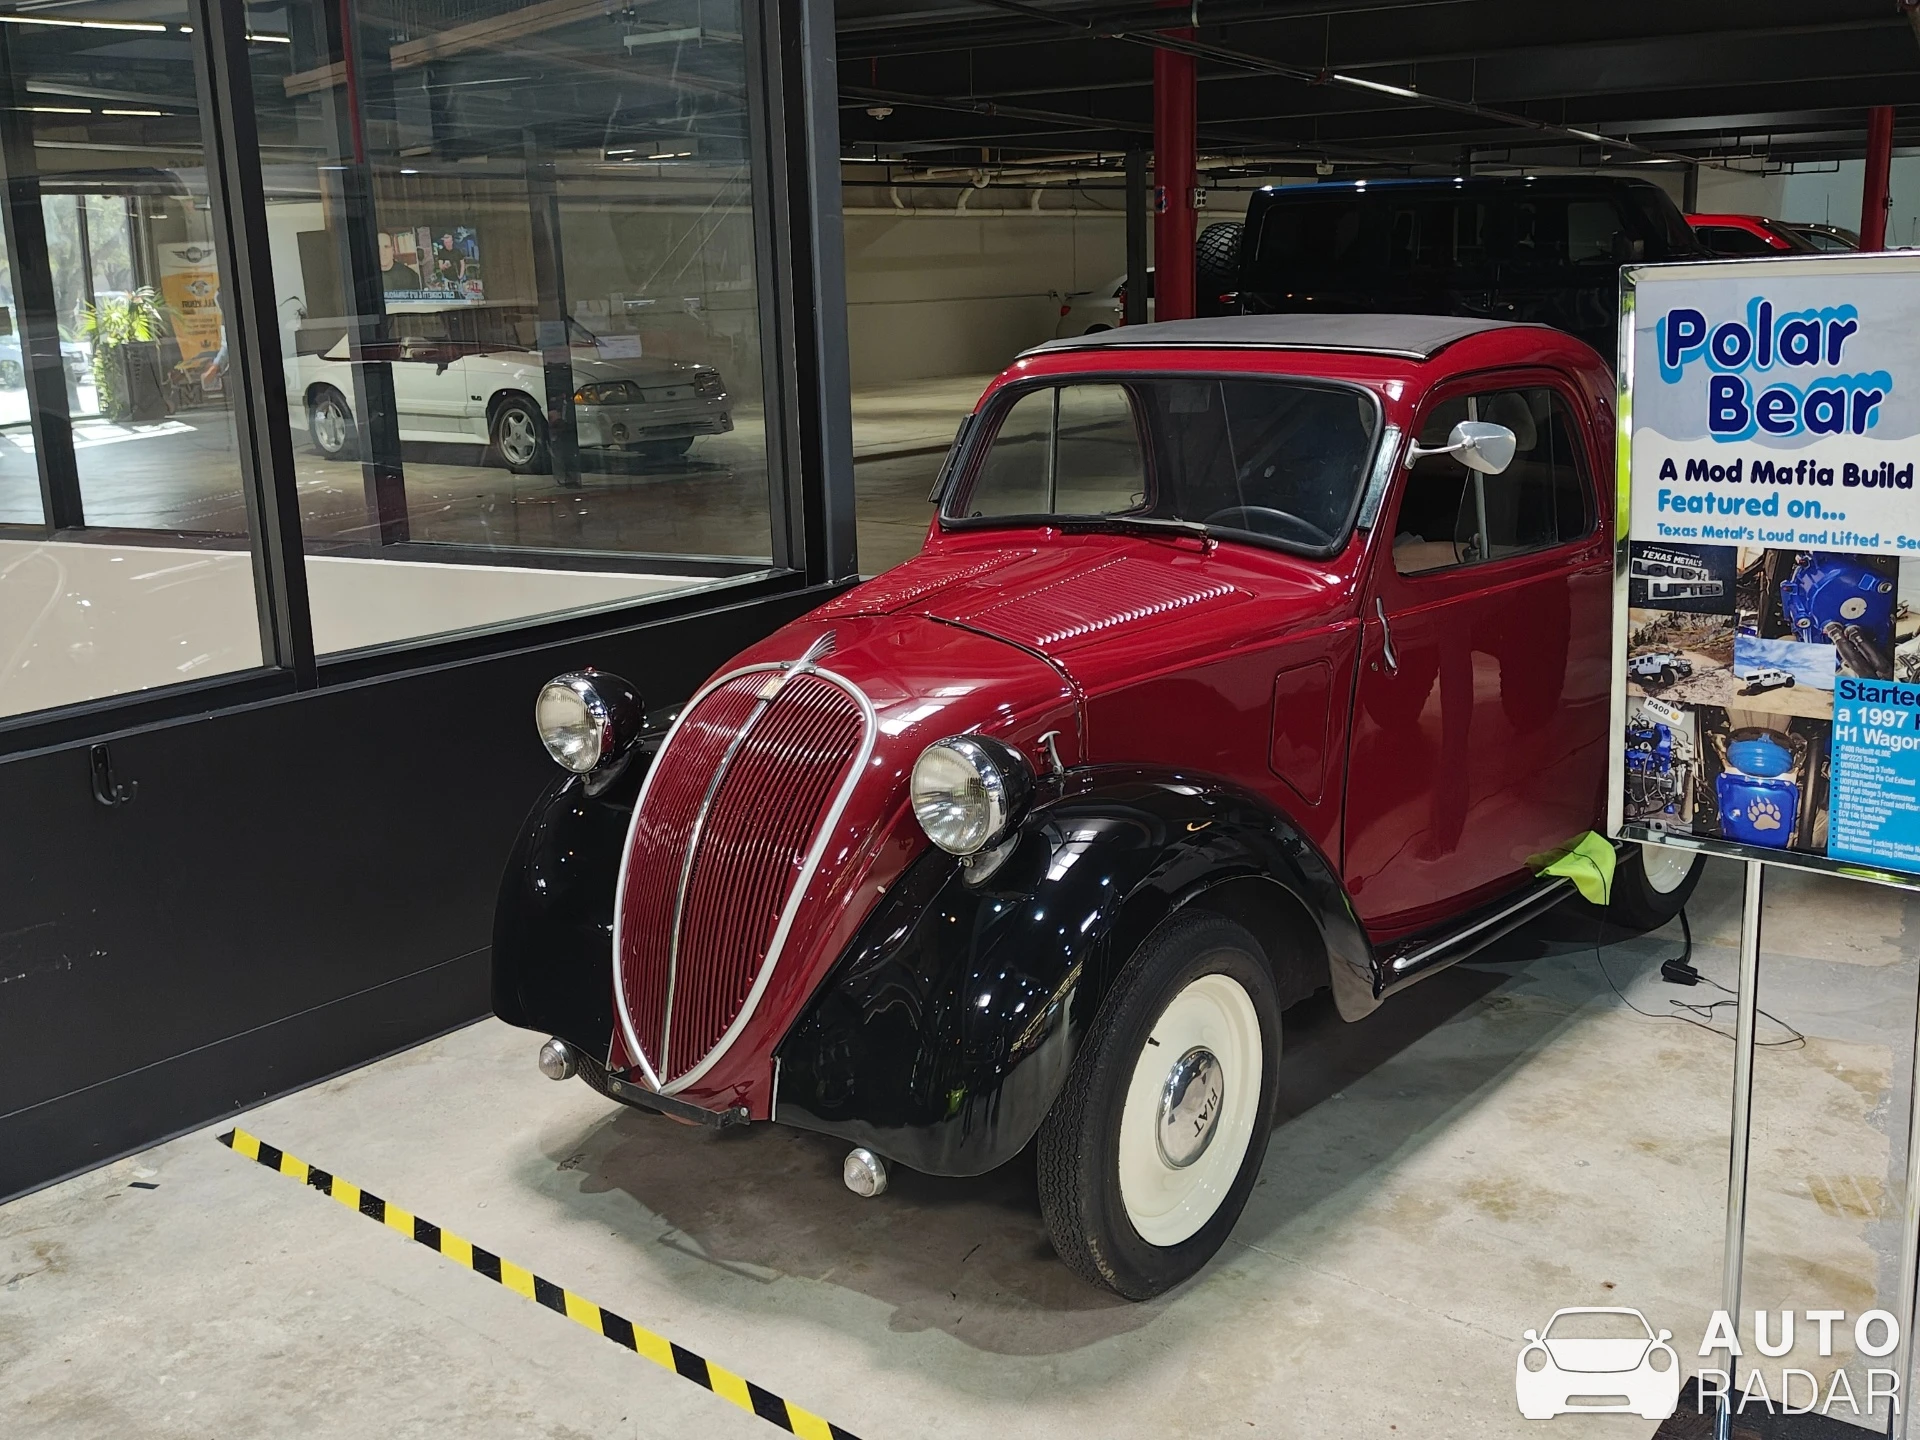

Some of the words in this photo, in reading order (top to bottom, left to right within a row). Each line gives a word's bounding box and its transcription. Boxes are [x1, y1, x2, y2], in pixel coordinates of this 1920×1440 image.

[1664, 299, 1858, 370] Polar
[1707, 372, 1884, 436] Bear
[1659, 458, 1678, 481] A
[1685, 458, 1743, 483] Mod
[1750, 459, 1835, 486] Mafia
[1842, 462, 1914, 489] Build
[1658, 489, 1779, 517] Featured
[1787, 499, 1846, 520] on...
[1657, 523, 1697, 537] Texas
[1701, 525, 1754, 540] Metal's
[1758, 528, 1794, 542] Loud
[1799, 530, 1827, 544] and
[1832, 531, 1879, 547] Lifted
[1642, 550, 1672, 562] TEXAS
[1673, 556, 1703, 567] METAL'S
[1632, 560, 1697, 580] LOUD
[1652, 582, 1722, 598] LIFTED
[1648, 700, 1670, 715] P400
[1837, 708, 1850, 723] a
[1857, 707, 1909, 728] 1997
[1835, 724, 1857, 743] H1
[1860, 764, 1875, 773] Stage
[1881, 766, 1895, 775] Turbo
[1860, 780, 1881, 789] Radiator
[1860, 797, 1879, 805] Lockers
[1881, 799, 1894, 807] Front
[1861, 789, 1876, 798] Stage
[1882, 792, 1915, 802] Performance
[1193, 1087, 1218, 1138] FIAT
